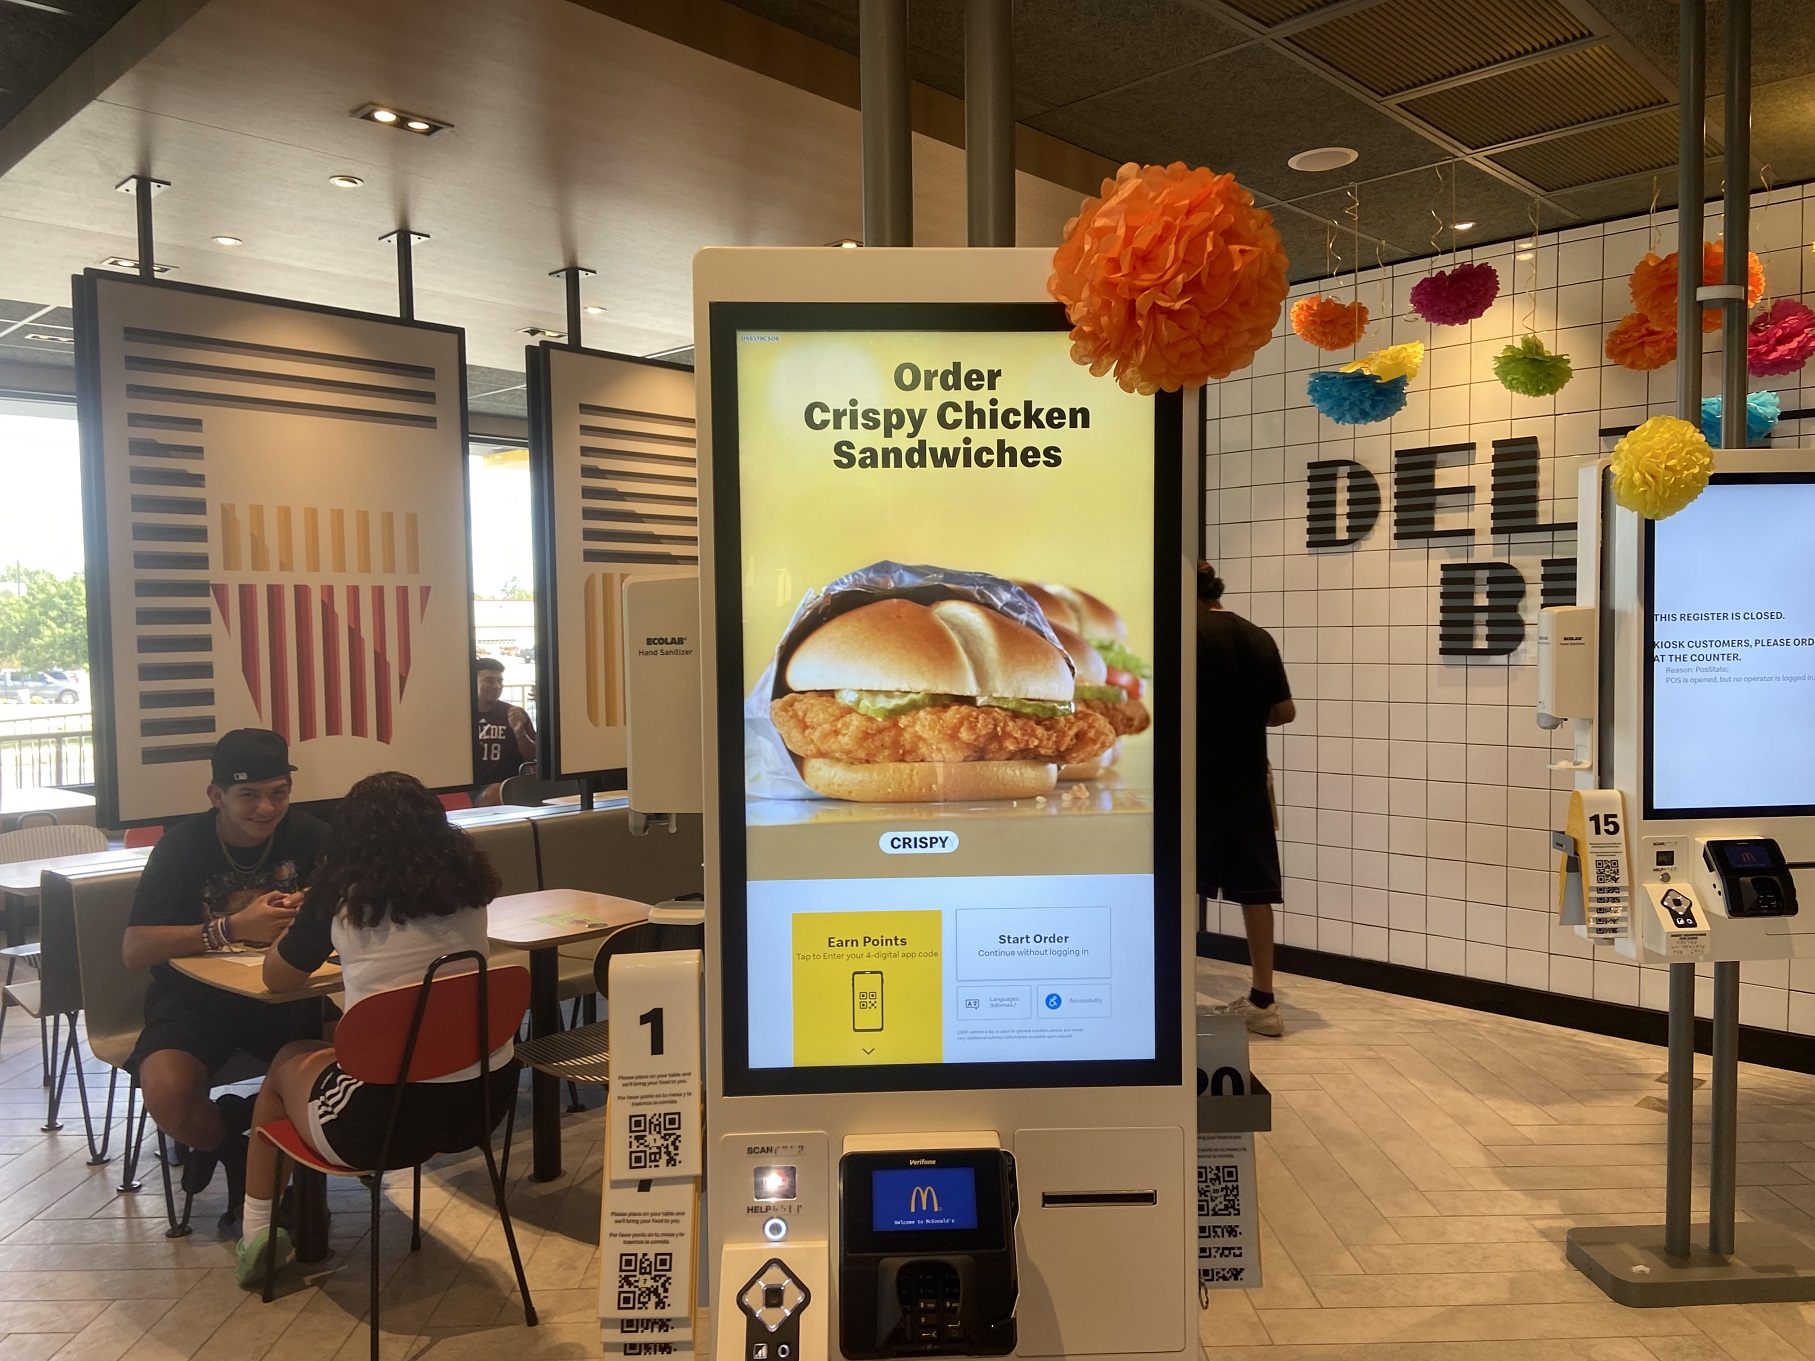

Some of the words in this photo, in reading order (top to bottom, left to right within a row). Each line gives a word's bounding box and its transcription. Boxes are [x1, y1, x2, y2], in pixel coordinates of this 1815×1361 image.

[894, 362, 1002, 391] Order
[804, 398, 928, 438] Crispy
[937, 398, 1090, 430] Chicken
[833, 437, 1062, 470] Sandwiches
[1654, 614, 1677, 622] THIS
[1680, 612, 1728, 621] REGISTER
[1731, 612, 1741, 620] IS
[1743, 612, 1785, 620] CLOSED.
[1654, 641, 1685, 649] KIOSK
[1687, 640, 1752, 649] CUSTOMERS,
[1754, 638, 1791, 647] PLEASE
[1690, 653, 1742, 662] COUNTER.
[482, 743, 501, 760] 18
[1589, 814, 1620, 835] 15
[890, 836, 949, 849] CRISPY
[828, 937, 859, 948] Earn
[863, 935, 907, 947] Points
[998, 934, 1030, 944] Start
[1033, 934, 1069, 944] Order
[797, 953, 810, 961] Tap
[866, 951, 899, 960] 4-digital
[1050, 948, 1080, 957] logging
[639, 1007, 664, 1055] 1
[747, 1146, 773, 1154] SCAN
